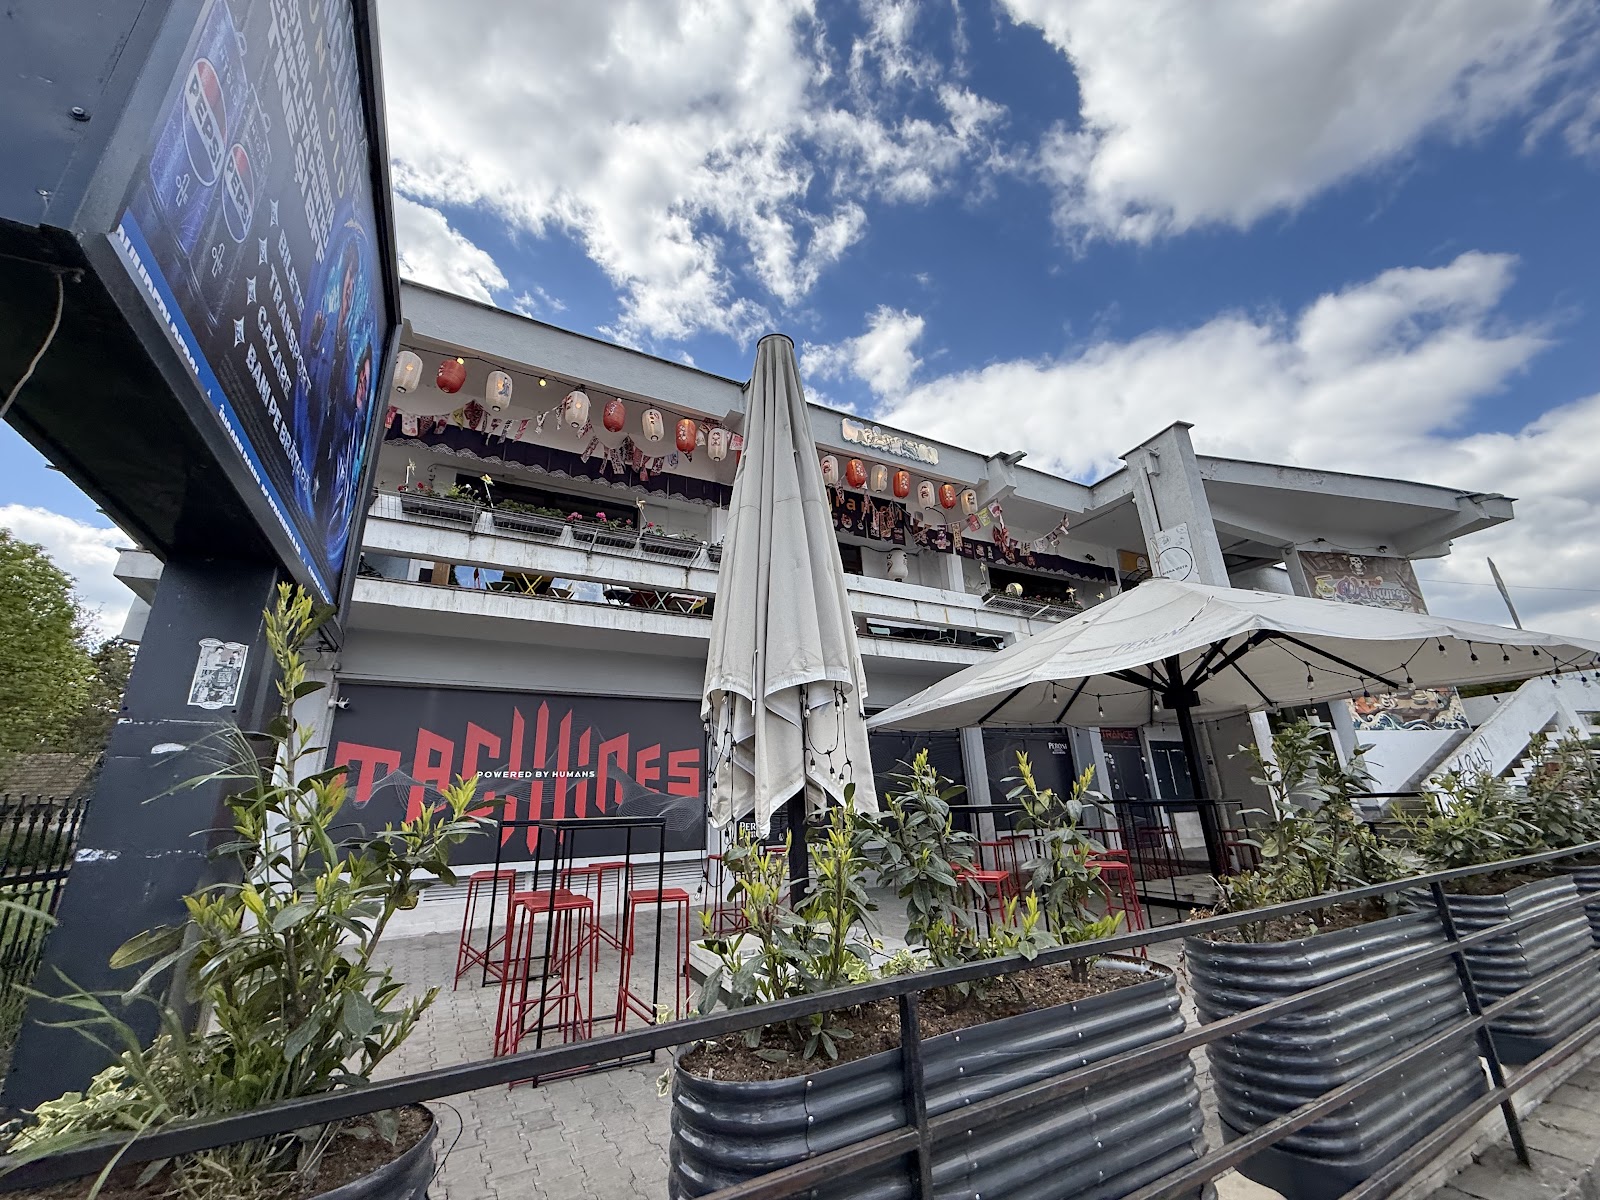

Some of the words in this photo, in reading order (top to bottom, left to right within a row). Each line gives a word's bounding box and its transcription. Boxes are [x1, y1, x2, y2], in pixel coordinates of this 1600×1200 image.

[188, 73, 222, 171] PEPSI
[267, 0, 298, 148] TINE
[294, 140, 309, 198] ȘI
[305, 189, 325, 265] BFF
[305, 81, 313, 109] O
[226, 154, 251, 231] PEPSI
[308, 153, 329, 249] PENTRU
[278, 229, 305, 322] BILETE
[257, 305, 292, 400] CAZARE
[269, 263, 312, 397] TRANSPORT
[246, 342, 271, 408] BANI
[268, 395, 282, 433] PE
[552, 770, 595, 778] HUMANS
